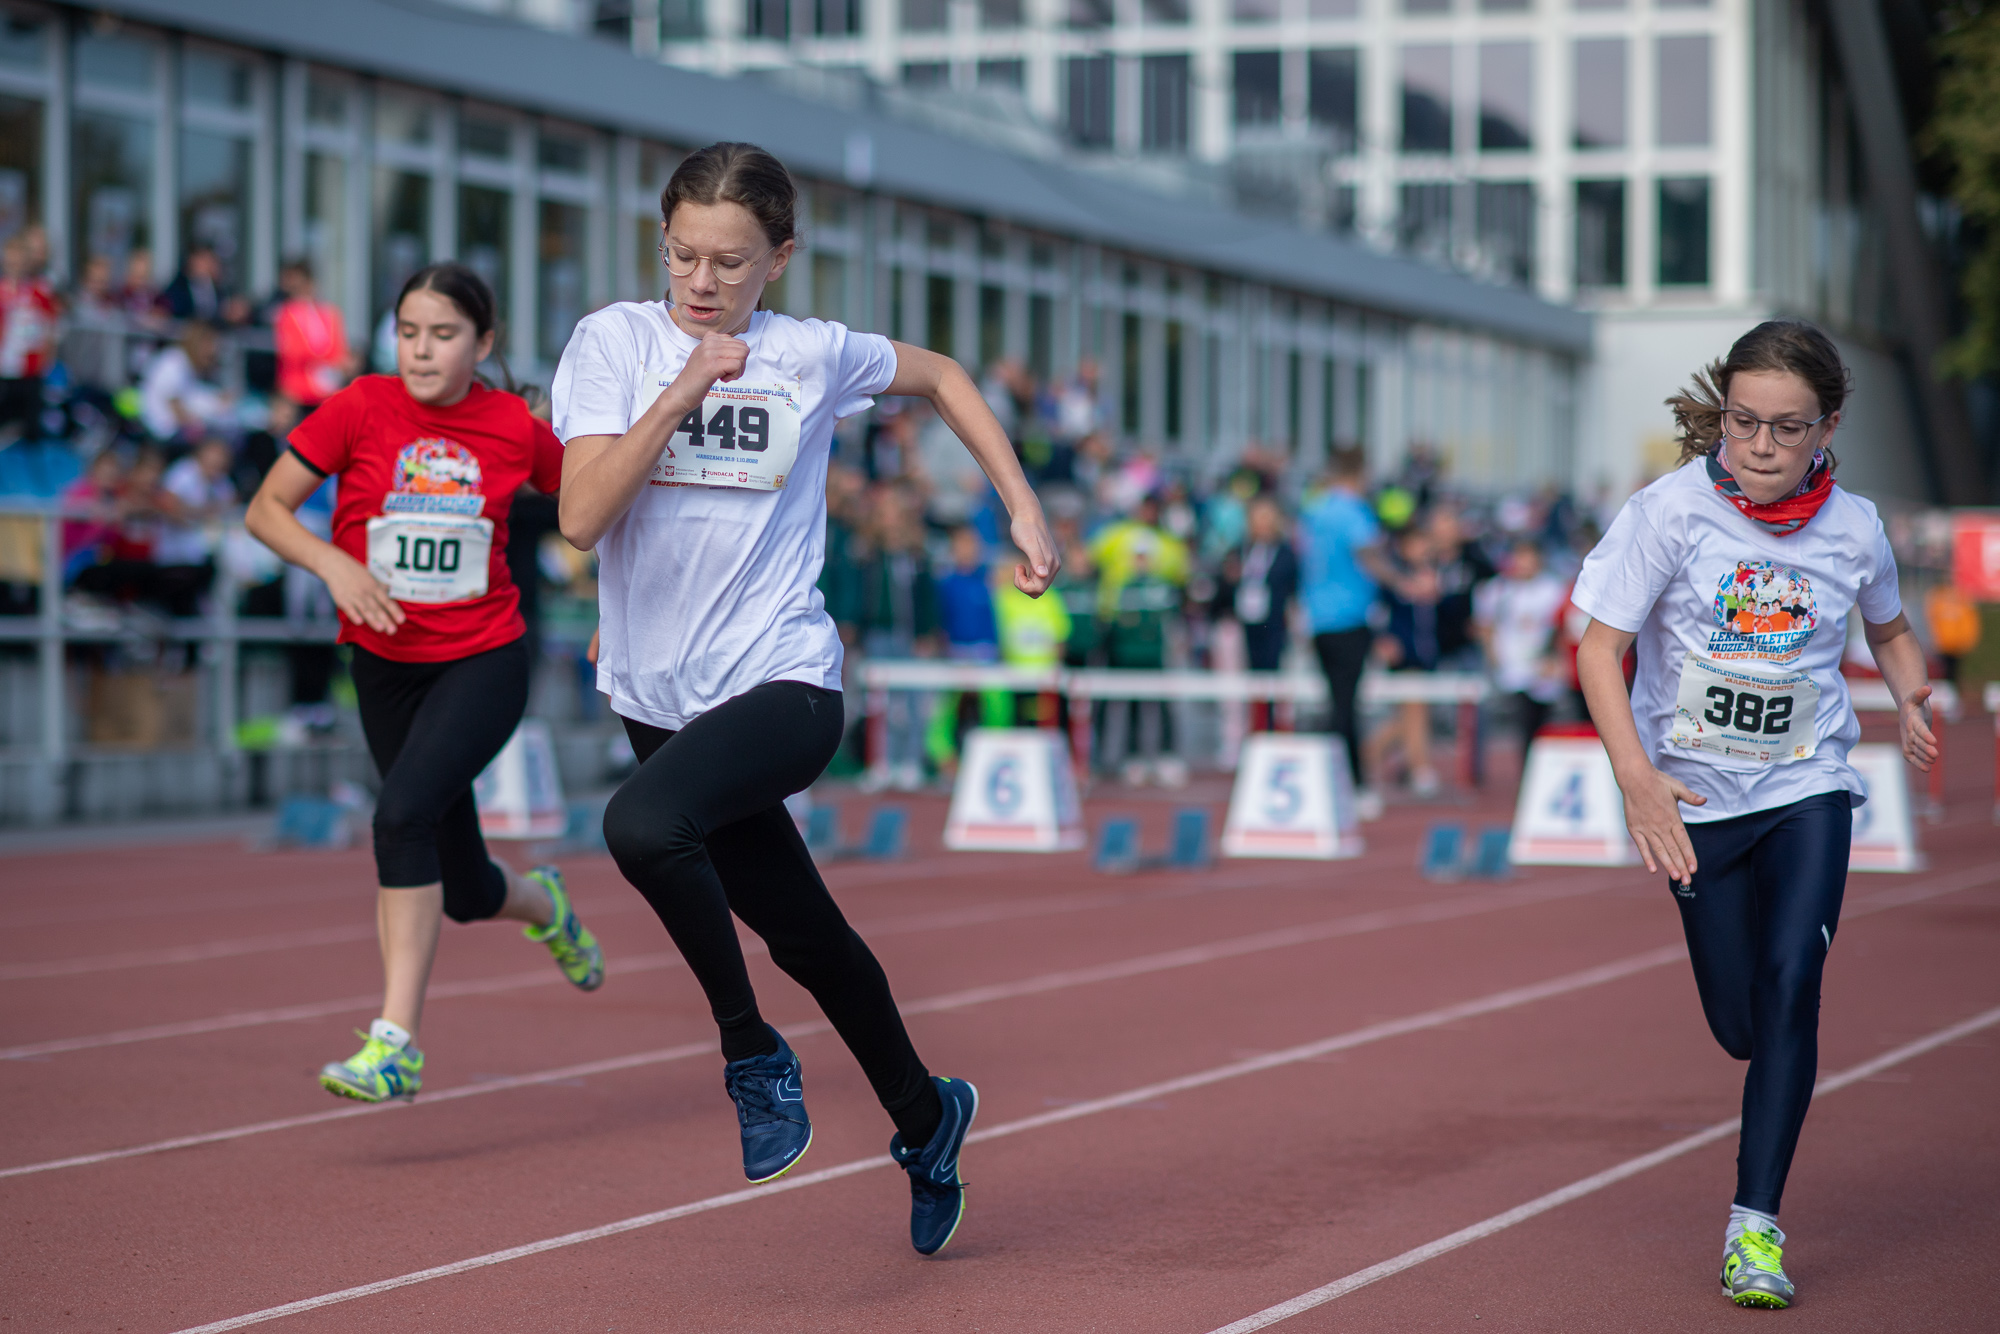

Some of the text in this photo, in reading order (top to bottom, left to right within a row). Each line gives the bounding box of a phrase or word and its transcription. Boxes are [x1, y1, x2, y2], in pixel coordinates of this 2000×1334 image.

[720, 386, 752, 394] NADZIEJE
[752, 388, 792, 398] OLIMPIJSKIE
[727, 393, 768, 402] NAJLEPSZYCH
[677, 402, 770, 453] 449
[696, 453, 723, 461] WARSZAWA
[395, 534, 461, 572] 100
[1709, 629, 1818, 645] LEKKOATLETYCZNE
[1707, 643, 1756, 652] NADZIEJE
[1711, 652, 1749, 660] NAJLEPSI
[1696, 660, 1751, 681] LEKKOATLETYCZNE
[1751, 676, 1781, 685] NADZIEJE
[1704, 685, 1794, 734] 382
[1731, 748, 1756, 756] FUNDACJA
[985, 755, 1023, 818] 6
[1263, 760, 1303, 823] 5
[1549, 771, 1588, 831] 4
